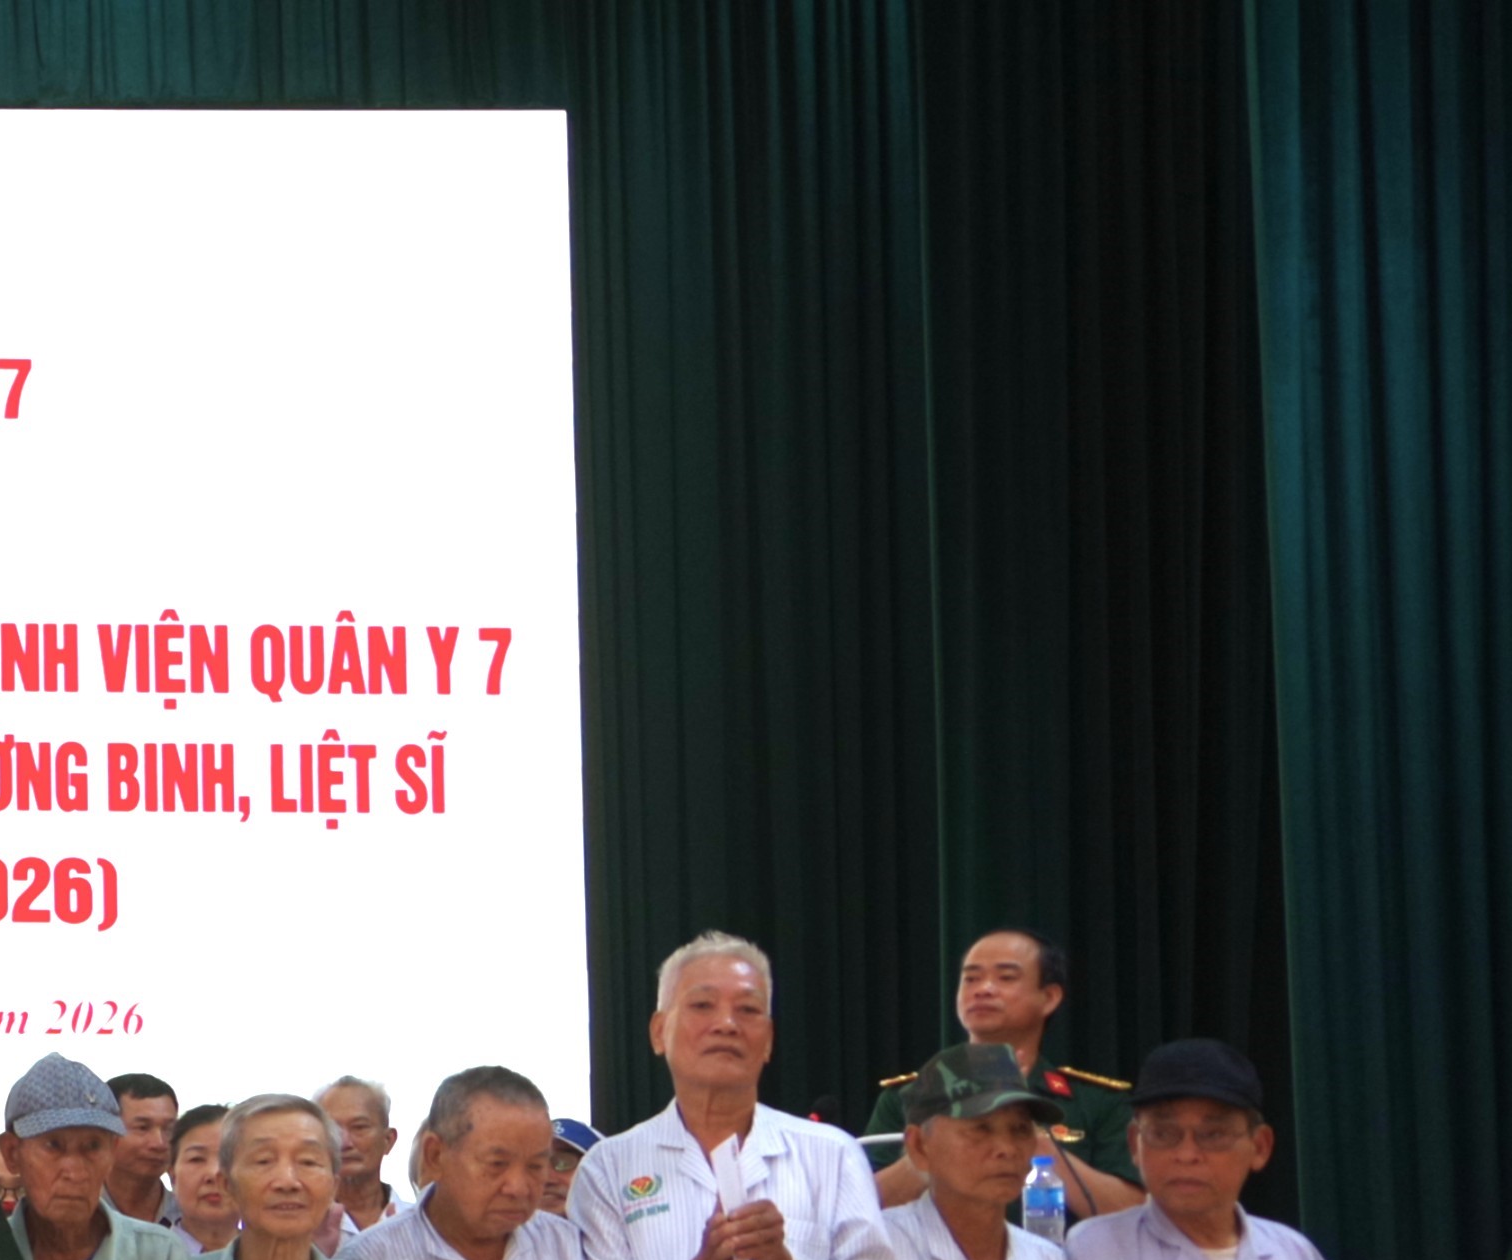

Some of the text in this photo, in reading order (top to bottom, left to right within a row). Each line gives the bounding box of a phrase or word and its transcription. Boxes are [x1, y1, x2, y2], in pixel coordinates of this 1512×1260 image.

[97, 608, 230, 710] VIỆN
[250, 609, 408, 703] QUÂN
[426, 626, 460, 695] Y
[478, 627, 513, 696] 7
[107, 742, 251, 823] BINH,
[270, 728, 378, 830] LIỆT
[394, 730, 448, 815] SĨ
[45, 1000, 144, 1035] 2026
